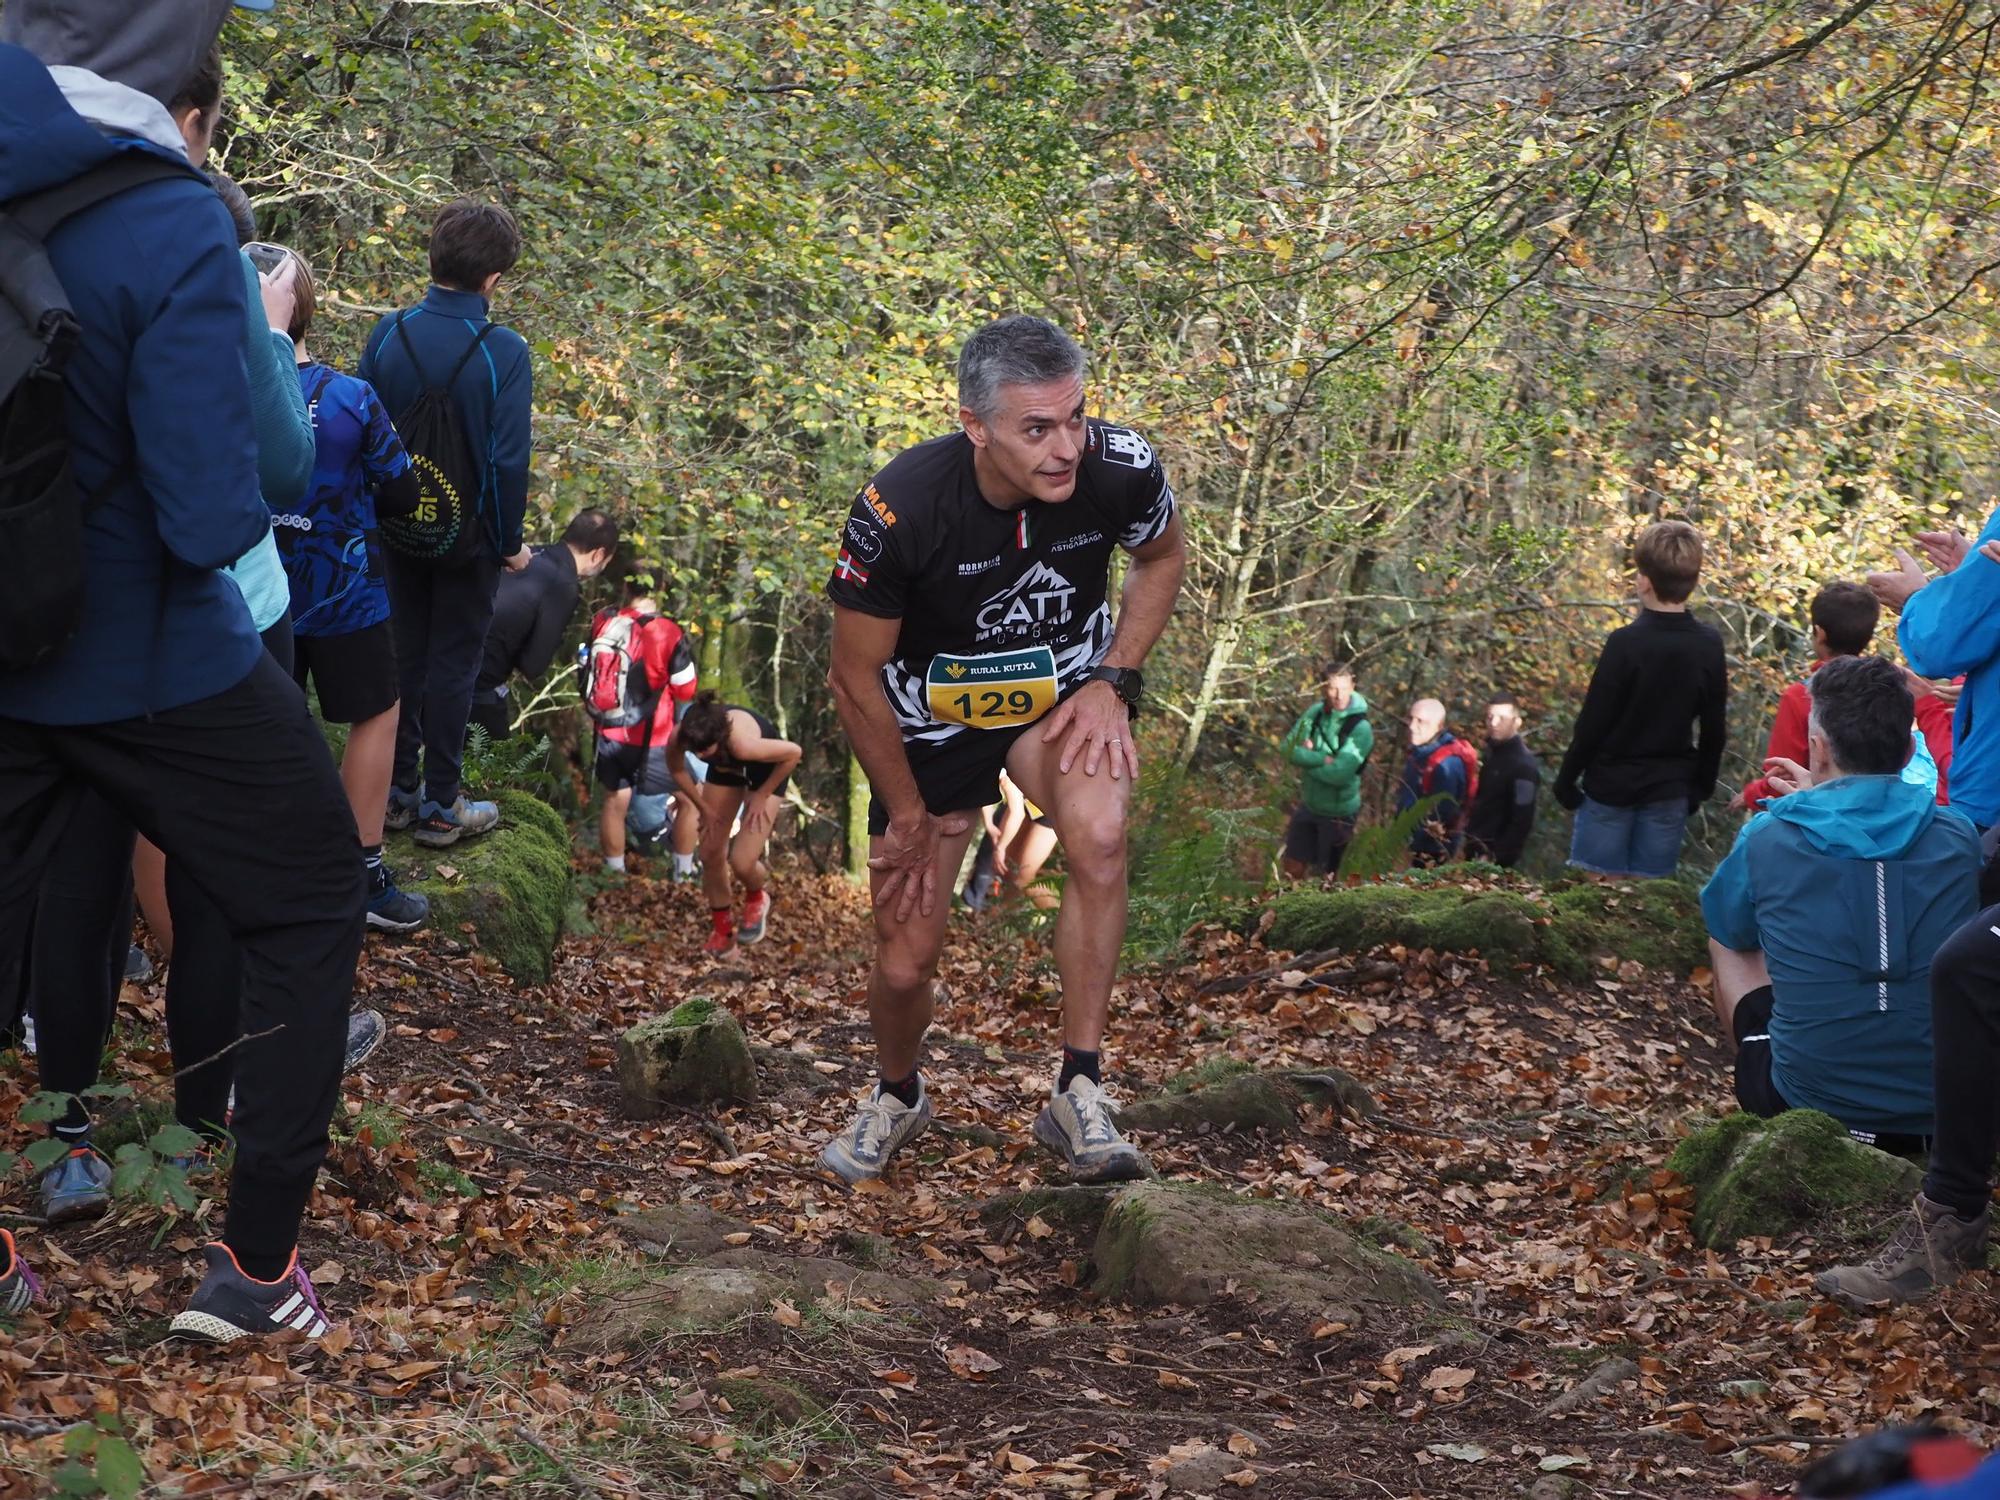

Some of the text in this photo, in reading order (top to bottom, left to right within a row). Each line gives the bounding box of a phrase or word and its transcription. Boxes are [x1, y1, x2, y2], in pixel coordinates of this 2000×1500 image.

[976, 587, 1076, 630] CATT
[970, 661, 1037, 675] RURAL KUTXA
[953, 690, 1034, 719] 129
